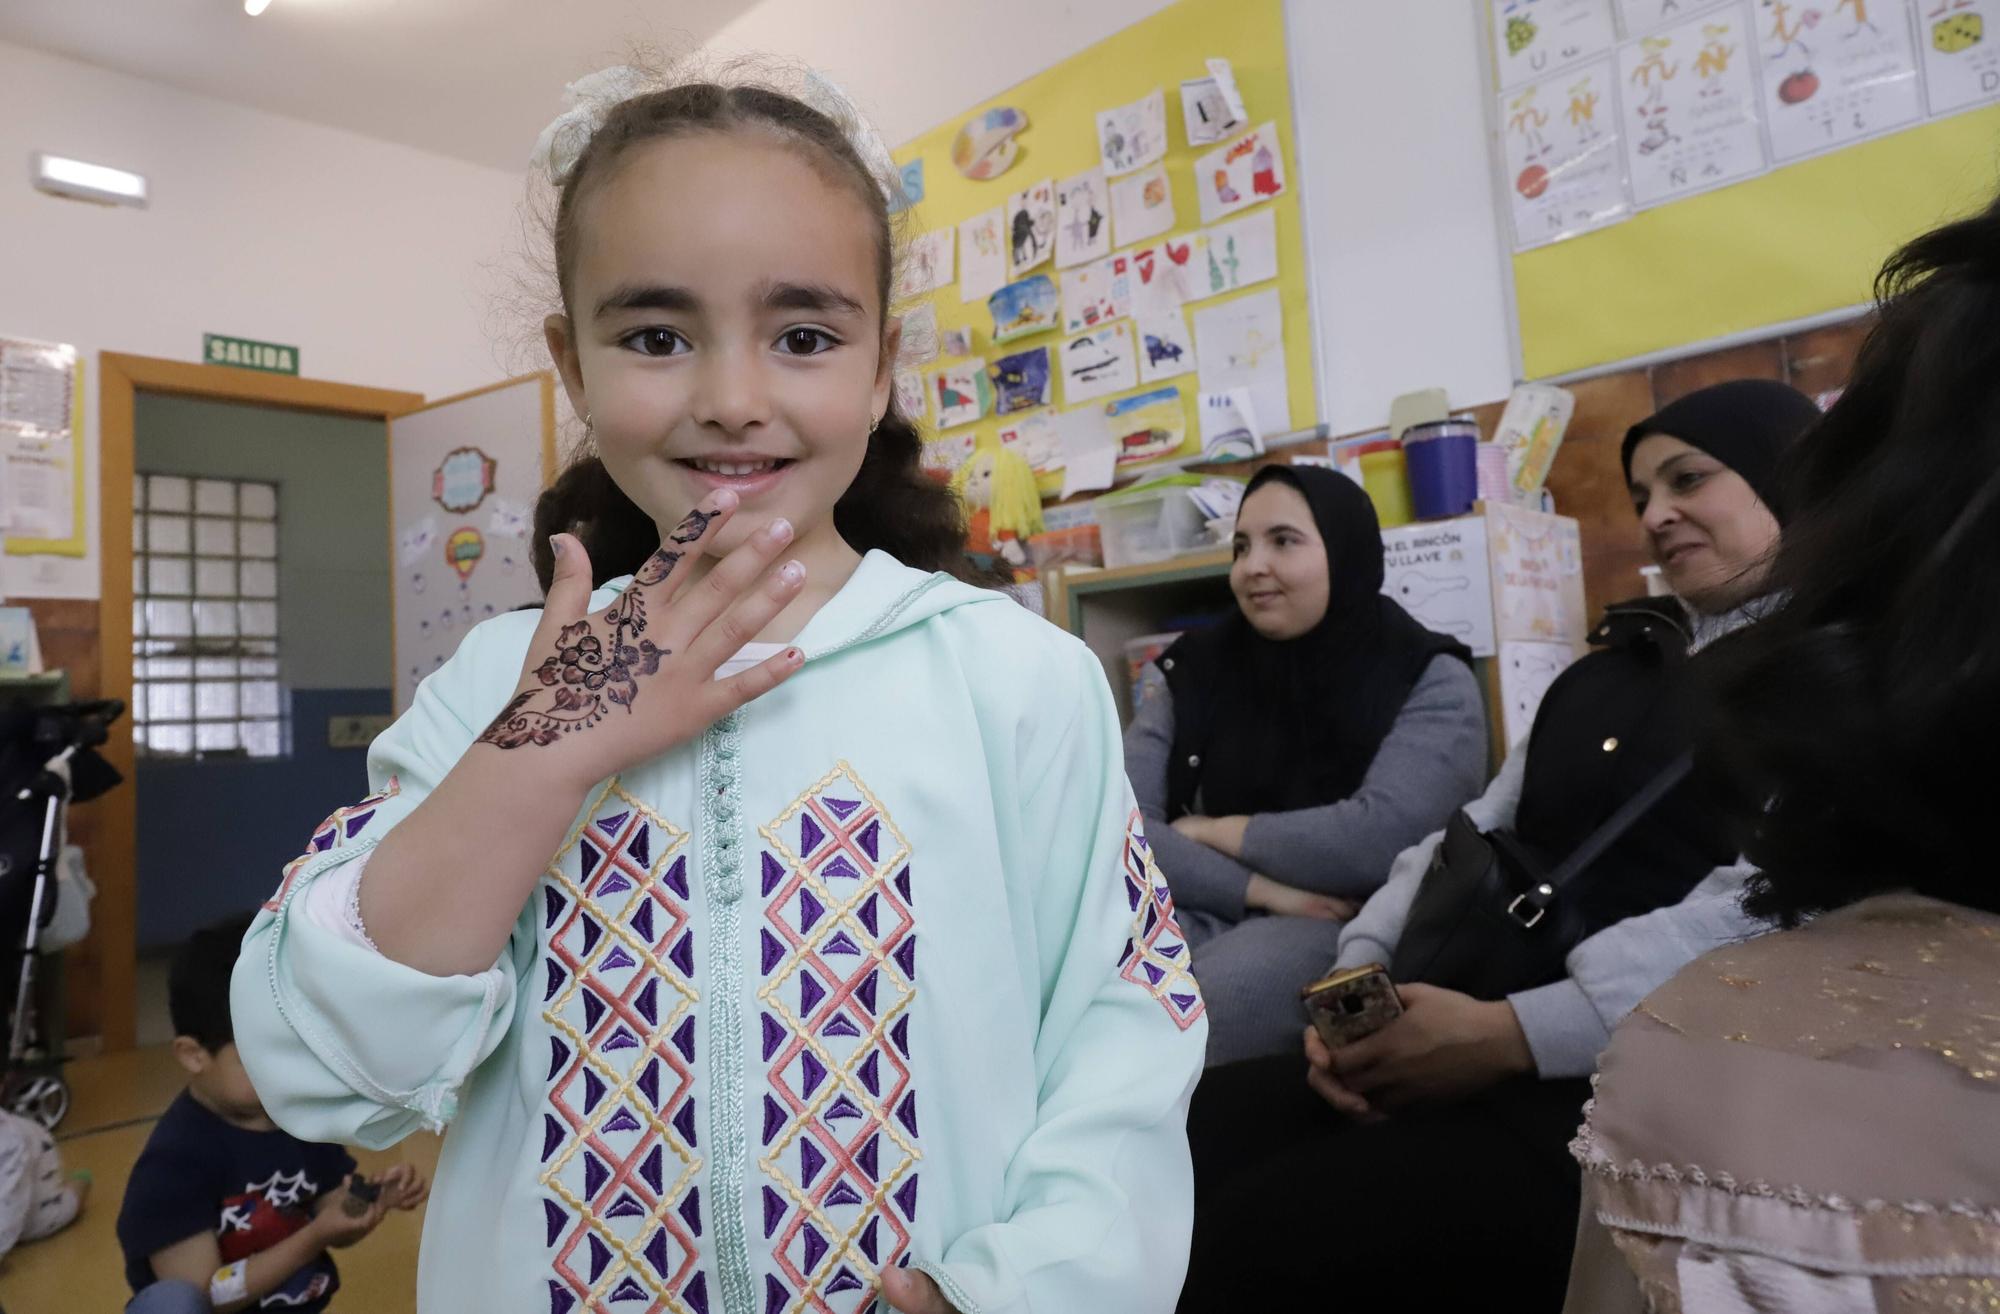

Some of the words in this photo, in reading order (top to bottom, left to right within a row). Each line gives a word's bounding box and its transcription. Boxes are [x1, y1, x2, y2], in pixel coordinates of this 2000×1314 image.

[1981, 70, 2000, 92] D
[210, 339, 293, 370] SALIDA
[1395, 541, 1408, 551] EL
[1412, 531, 1462, 549] RINCÓN
[1400, 550, 1442, 567] LLAVE
